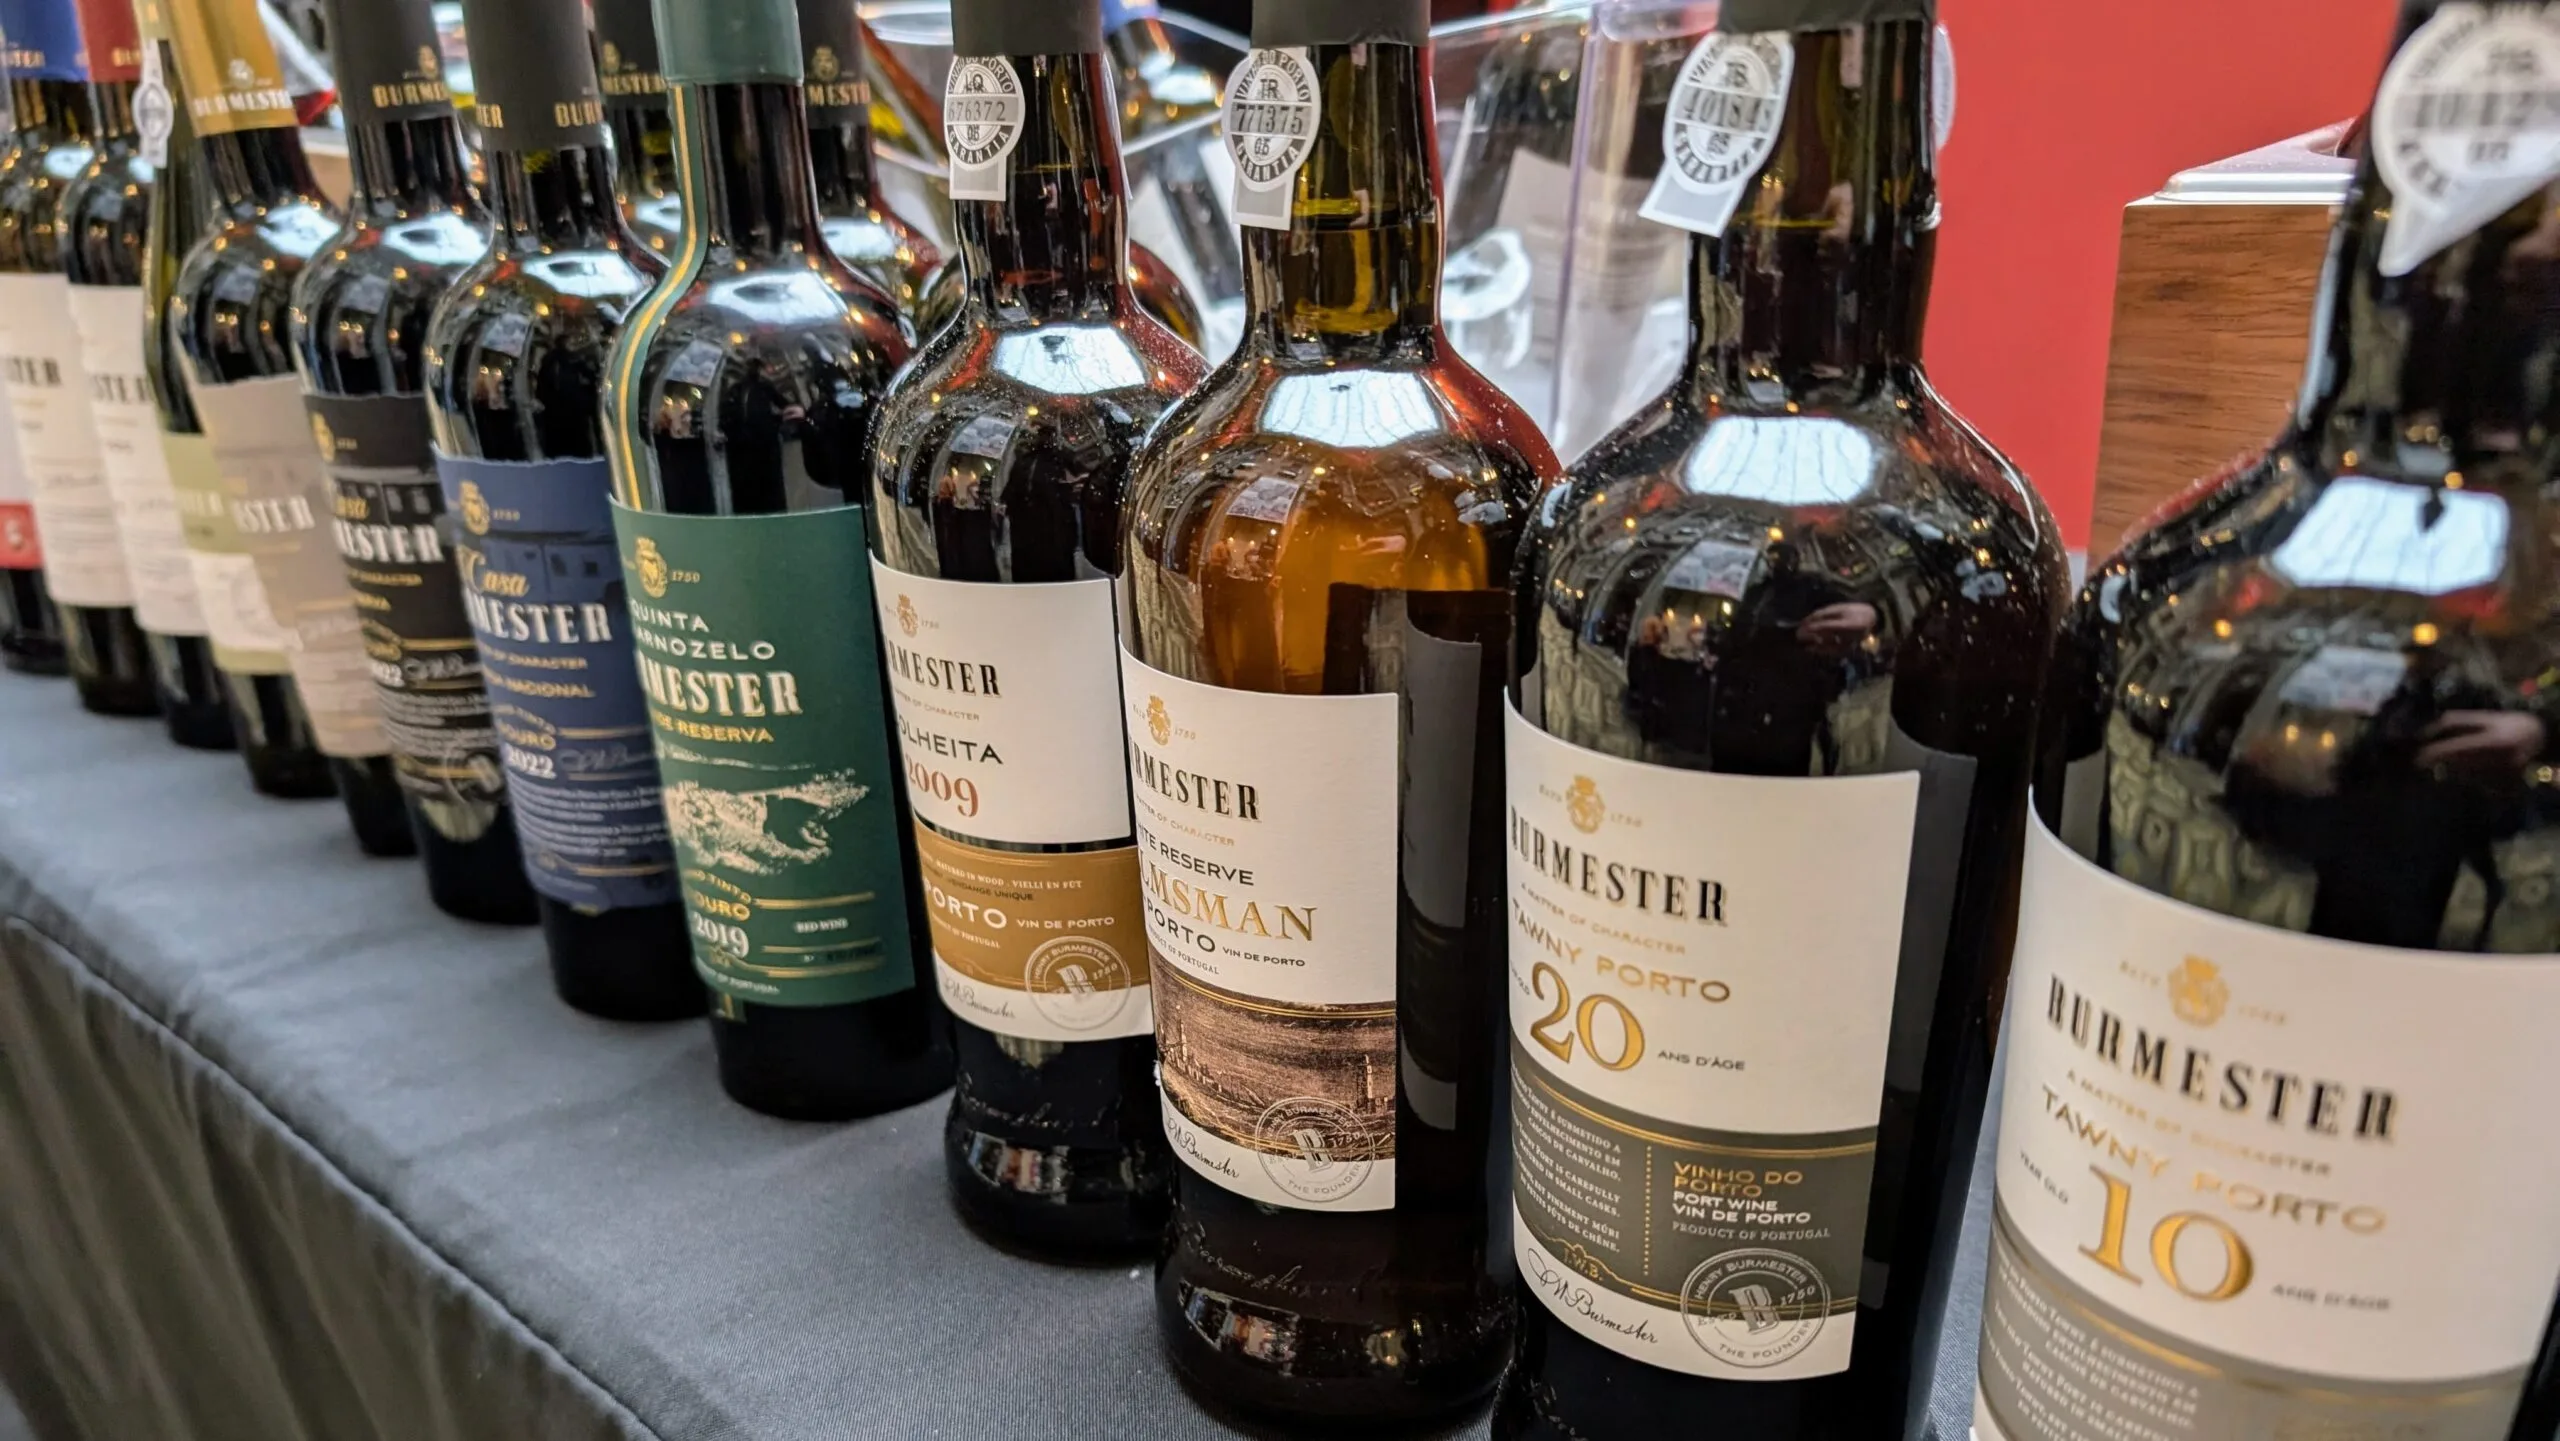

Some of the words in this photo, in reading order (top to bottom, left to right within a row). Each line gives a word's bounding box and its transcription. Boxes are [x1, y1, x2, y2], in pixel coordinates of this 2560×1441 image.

[677, 721, 775, 744] RESERVA
[1160, 841, 1255, 887] RESERVE
[1511, 803, 1731, 930] BURMESTER
[924, 876, 1008, 930] PORTO
[1016, 919, 1040, 929] VIN
[1044, 920, 1063, 929] DE
[1067, 916, 1115, 929] PORTO
[692, 910, 750, 959] 2019
[1146, 900, 1217, 954] PORTO
[1222, 946, 1242, 958] VIN
[1244, 952, 1261, 963] DE
[1263, 955, 1307, 968] PORTO
[1512, 896, 1584, 966] TAWNY
[1596, 954, 1732, 1003] PORTO
[1592, 922, 1687, 956] CHARACTER
[1178, 949, 1220, 975] PORTUGAL
[1529, 960, 1647, 1073] 20
[1657, 1050, 1691, 1070] ANS
[2047, 973, 2402, 1147] BURMESTER
[1604, 1155, 1621, 1168] EM
[1673, 1160, 1756, 1185] VINHO
[1762, 1170, 1804, 1186] DO
[2041, 1082, 2172, 1181] TAWNY
[2191, 1167, 2388, 1237] PORTO
[1287, 1179, 1311, 1194] THE
[1313, 1163, 1364, 1195] FOUNDER
[1554, 1175, 1584, 1200] SMALL
[1565, 1170, 1621, 1204] CAREFULLY
[1673, 1177, 1763, 1200] PORTO
[2043, 1177, 2069, 1206] OLD
[1672, 1189, 1724, 1209] PORT
[1727, 1198, 1779, 1213] WINE
[1672, 1202, 1706, 1220] VIN
[1711, 1208, 1739, 1224] DE
[1744, 1210, 1813, 1226] PORTO
[1567, 1221, 1581, 1236] DE
[1672, 1219, 1735, 1241] PRODUCT
[1738, 1229, 1758, 1242] OF
[1760, 1226, 1832, 1243] PORTUGAL
[2078, 1163, 2255, 1304] 10
[1694, 1267, 1724, 1301] HENRY
[1725, 1256, 1808, 1286] BURMESTER
[1779, 1283, 1816, 1308] 1750
[1719, 1340, 1745, 1360] THE
[1751, 1318, 1812, 1361] FOUNDER
